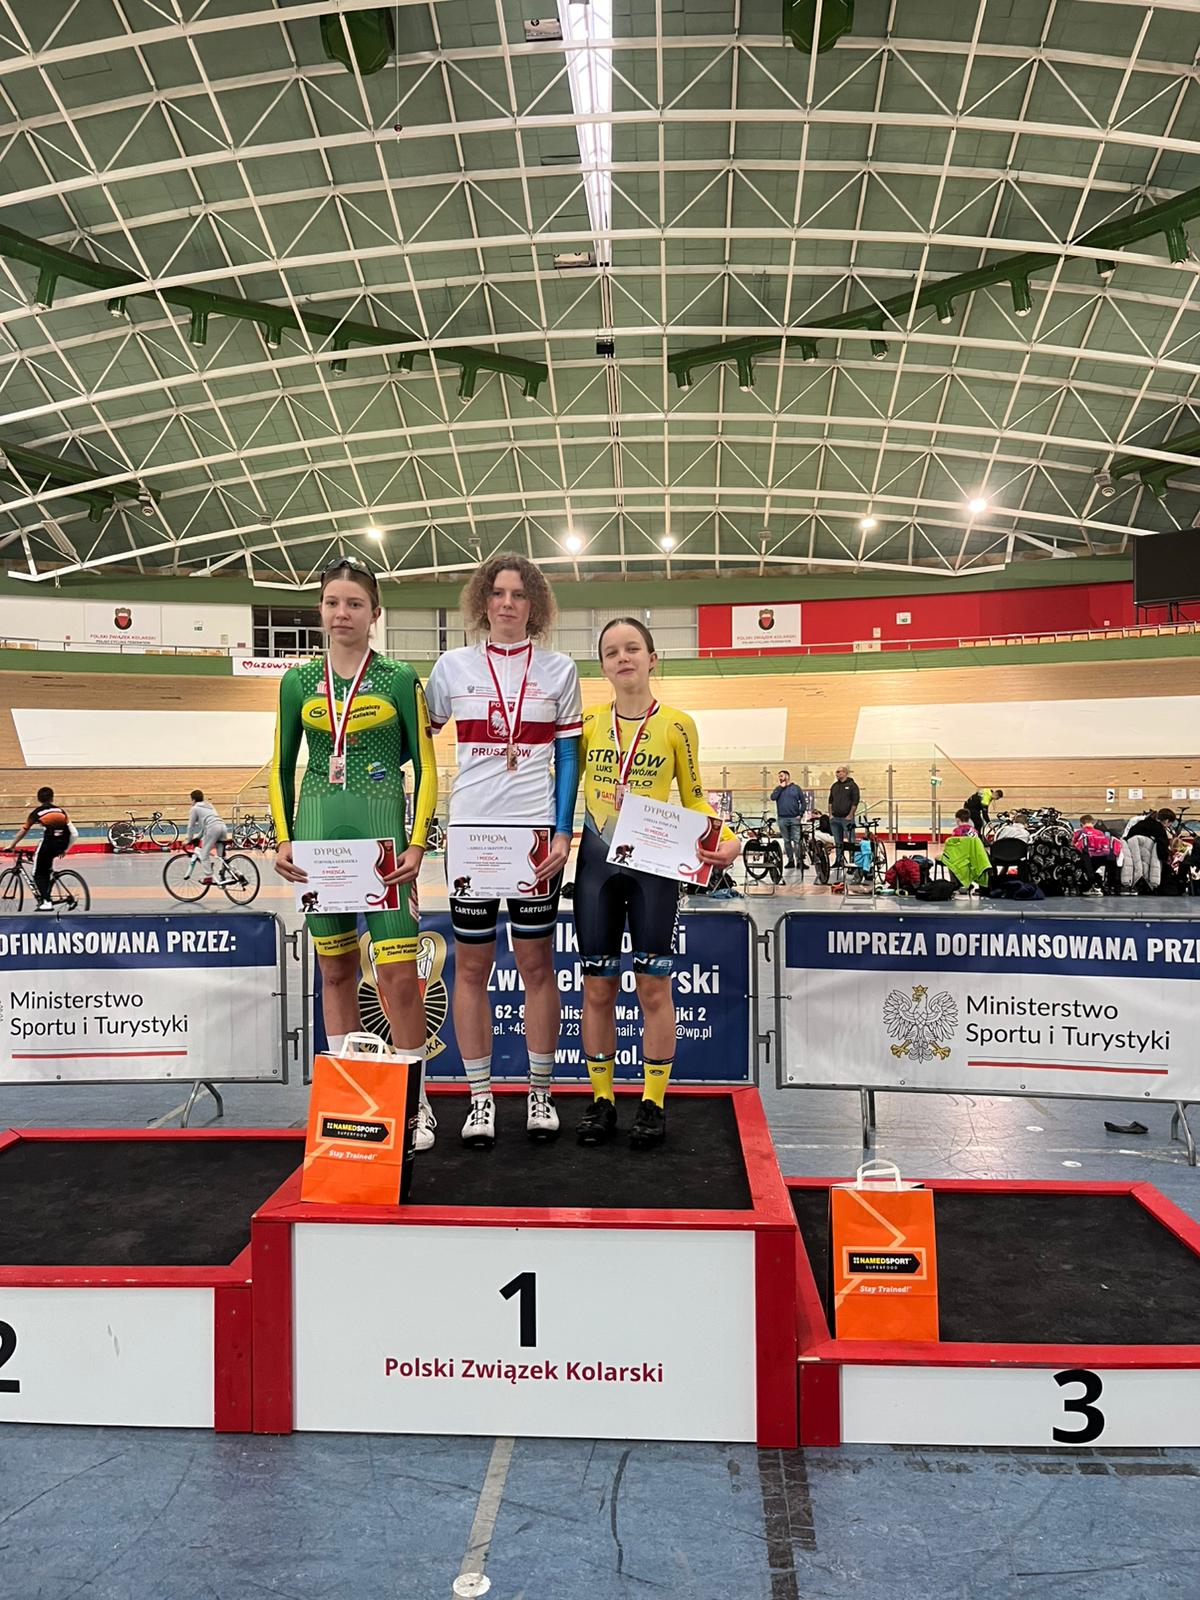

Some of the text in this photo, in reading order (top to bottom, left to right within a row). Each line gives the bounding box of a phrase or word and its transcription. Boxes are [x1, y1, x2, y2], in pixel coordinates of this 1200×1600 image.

[471, 746, 531, 758] PRUSZÓW
[588, 749, 666, 768] STRYÓW
[596, 764, 613, 773] LUKS
[644, 804, 680, 822] DYPLOM
[469, 834, 507, 843] DYPLOM
[314, 847, 352, 857] DYPLOM
[455, 906, 488, 915] CARTUSIA
[520, 904, 552, 914] CARTUSIA
[167, 930, 236, 953] PRZEZ:
[828, 931, 927, 956] IMPREZA
[936, 933, 1137, 962] DOFINANSOWANA
[10, 991, 144, 1010] Ministerstwo
[966, 995, 1119, 1020] Ministerstwo
[615, 1005, 639, 1020] Wał
[697, 1007, 706, 1021] 2
[10, 1015, 188, 1039] Sportu i Turystyki
[966, 1022, 1171, 1053] Sportu i Turystyki
[333, 1122, 379, 1134] NAMEDSPORT
[329, 1150, 345, 1159] Stay
[860, 1257, 909, 1265] NAMEDSPORT
[859, 1285, 876, 1293] Stay
[499, 1272, 536, 1347] 1
[385, 1357, 663, 1384] Polski Związek Kolarski
[1053, 1369, 1104, 1444] 3
